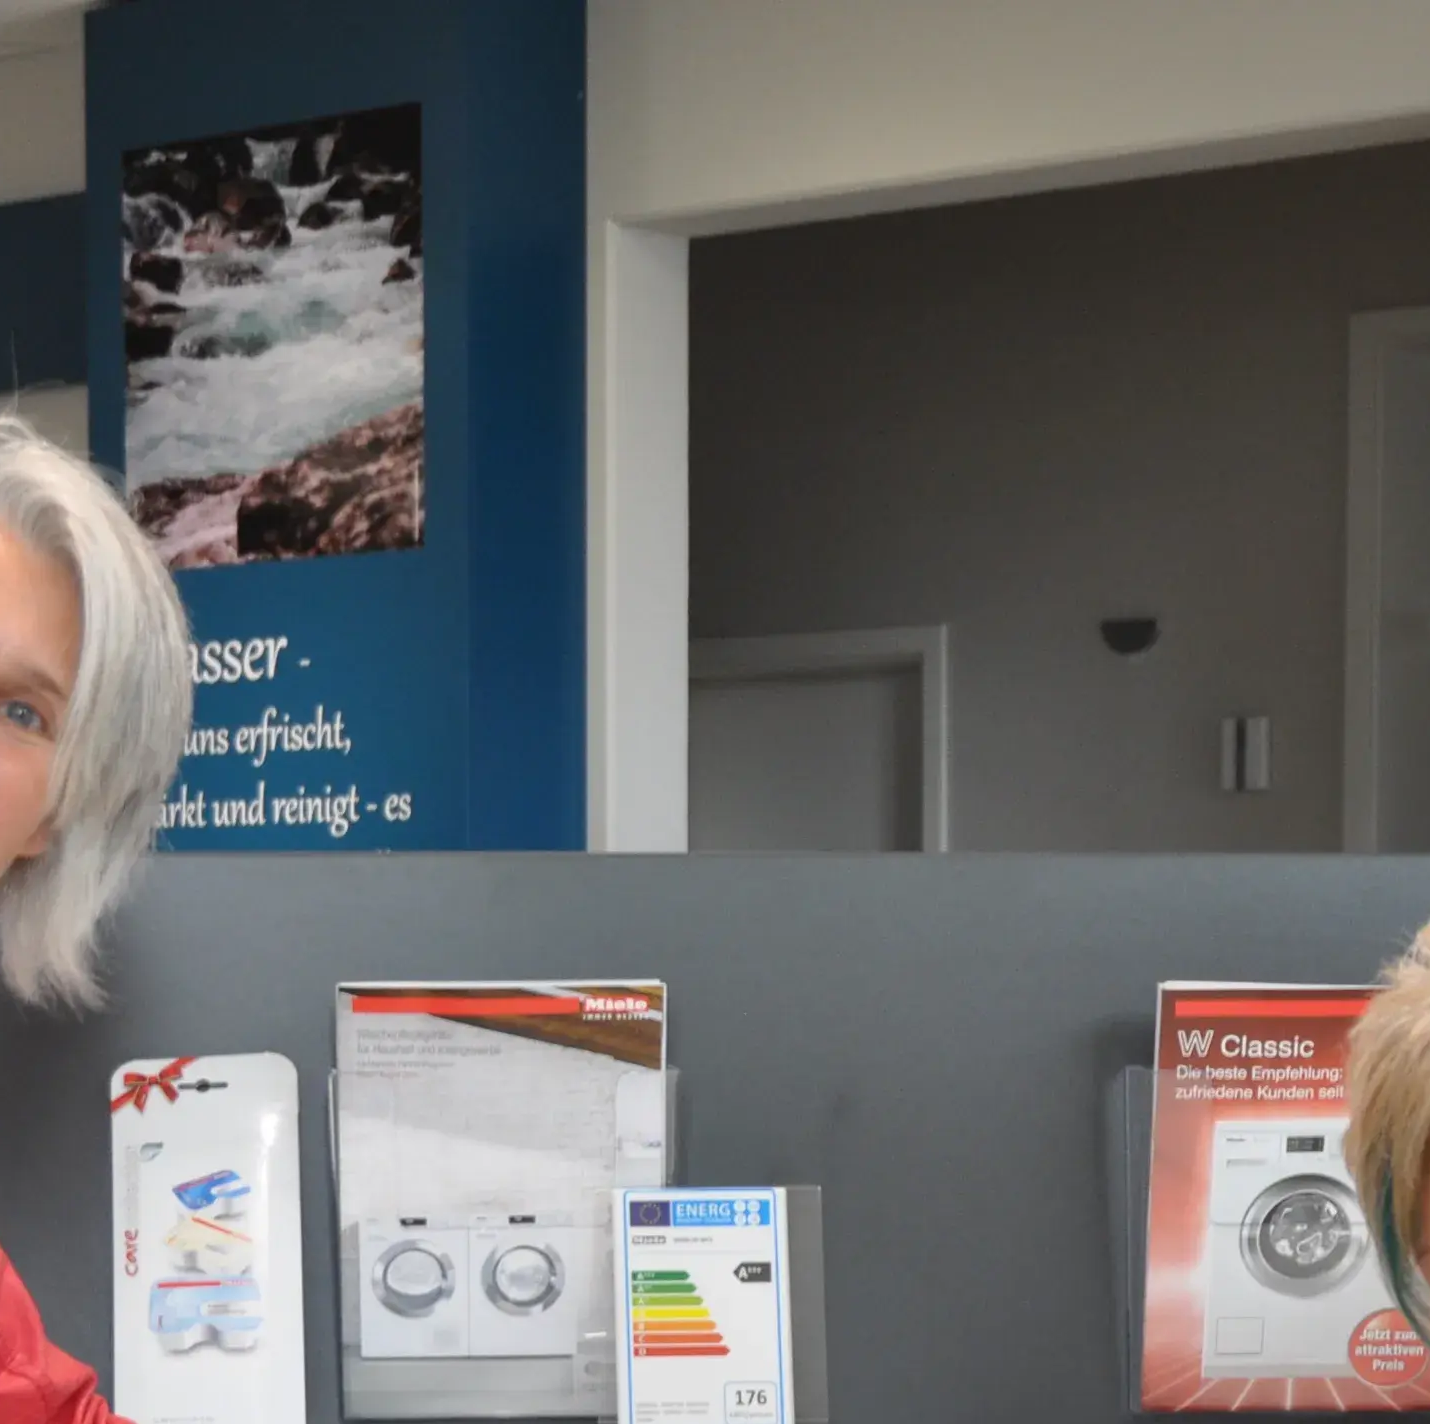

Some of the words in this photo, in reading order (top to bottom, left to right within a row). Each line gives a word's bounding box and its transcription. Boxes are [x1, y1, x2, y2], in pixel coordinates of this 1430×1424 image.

[183, 727, 229, 756] uns
[235, 704, 351, 767] erfrischt,
[212, 780, 267, 827] und
[272, 784, 361, 838] reinigt
[384, 792, 412, 821] es
[585, 997, 648, 1012] Miele
[1178, 1030, 1214, 1058] W
[1220, 1034, 1315, 1058] Classic
[1176, 1065, 1201, 1080] Die
[1205, 1065, 1247, 1080] beste
[1251, 1065, 1343, 1083] Empfehlung:
[1175, 1085, 1253, 1100] zufriedene
[1257, 1085, 1314, 1100] Kunden
[1318, 1085, 1344, 1100] seit
[676, 1202, 731, 1218] ENERG
[124, 1228, 139, 1277] care
[1359, 1328, 1391, 1341] Jetzt
[1354, 1343, 1424, 1356] attraktiven
[1372, 1358, 1406, 1372] Preis
[735, 1389, 768, 1407] 176
